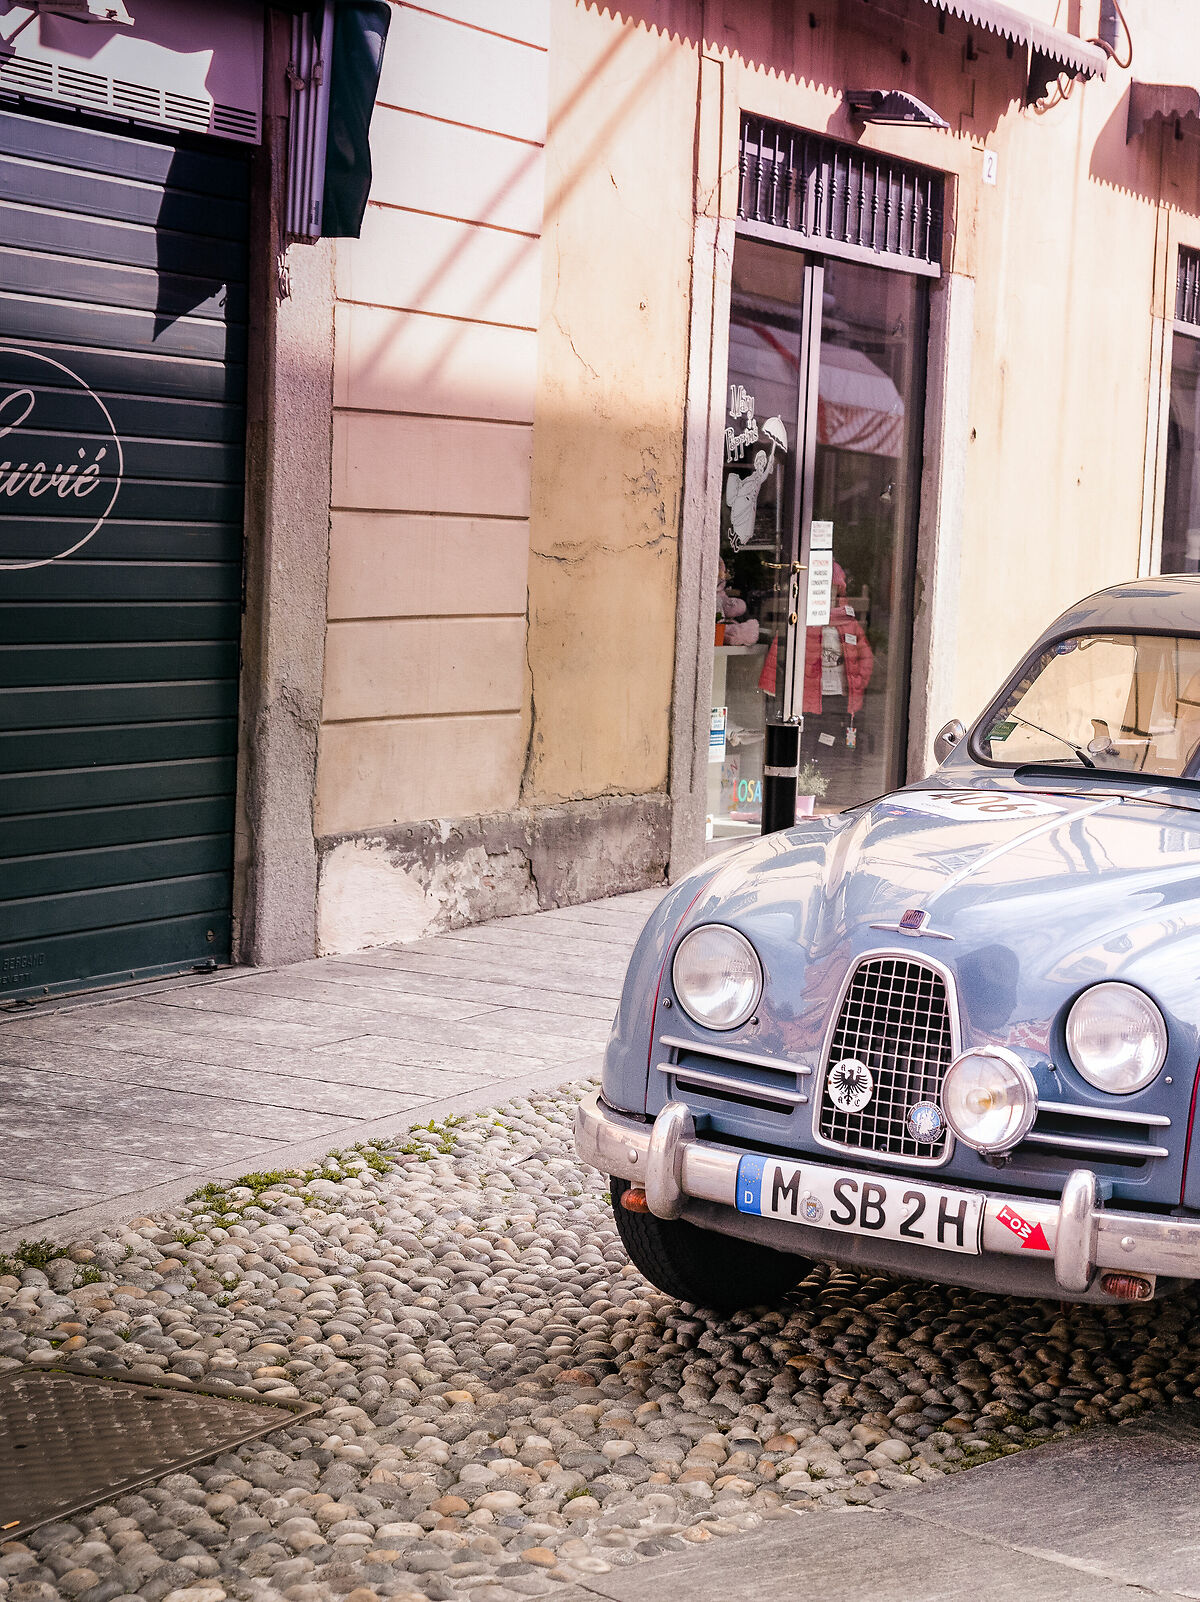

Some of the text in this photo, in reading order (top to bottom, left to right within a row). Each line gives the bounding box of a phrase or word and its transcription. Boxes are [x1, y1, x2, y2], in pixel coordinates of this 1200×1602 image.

[987, 156, 993, 178] 2
[729, 385, 755, 420] Mary
[928, 792, 1037, 812] 406
[744, 1190, 753, 1204] D
[771, 1166, 802, 1216] M
[1000, 1209, 1033, 1239] TOW
